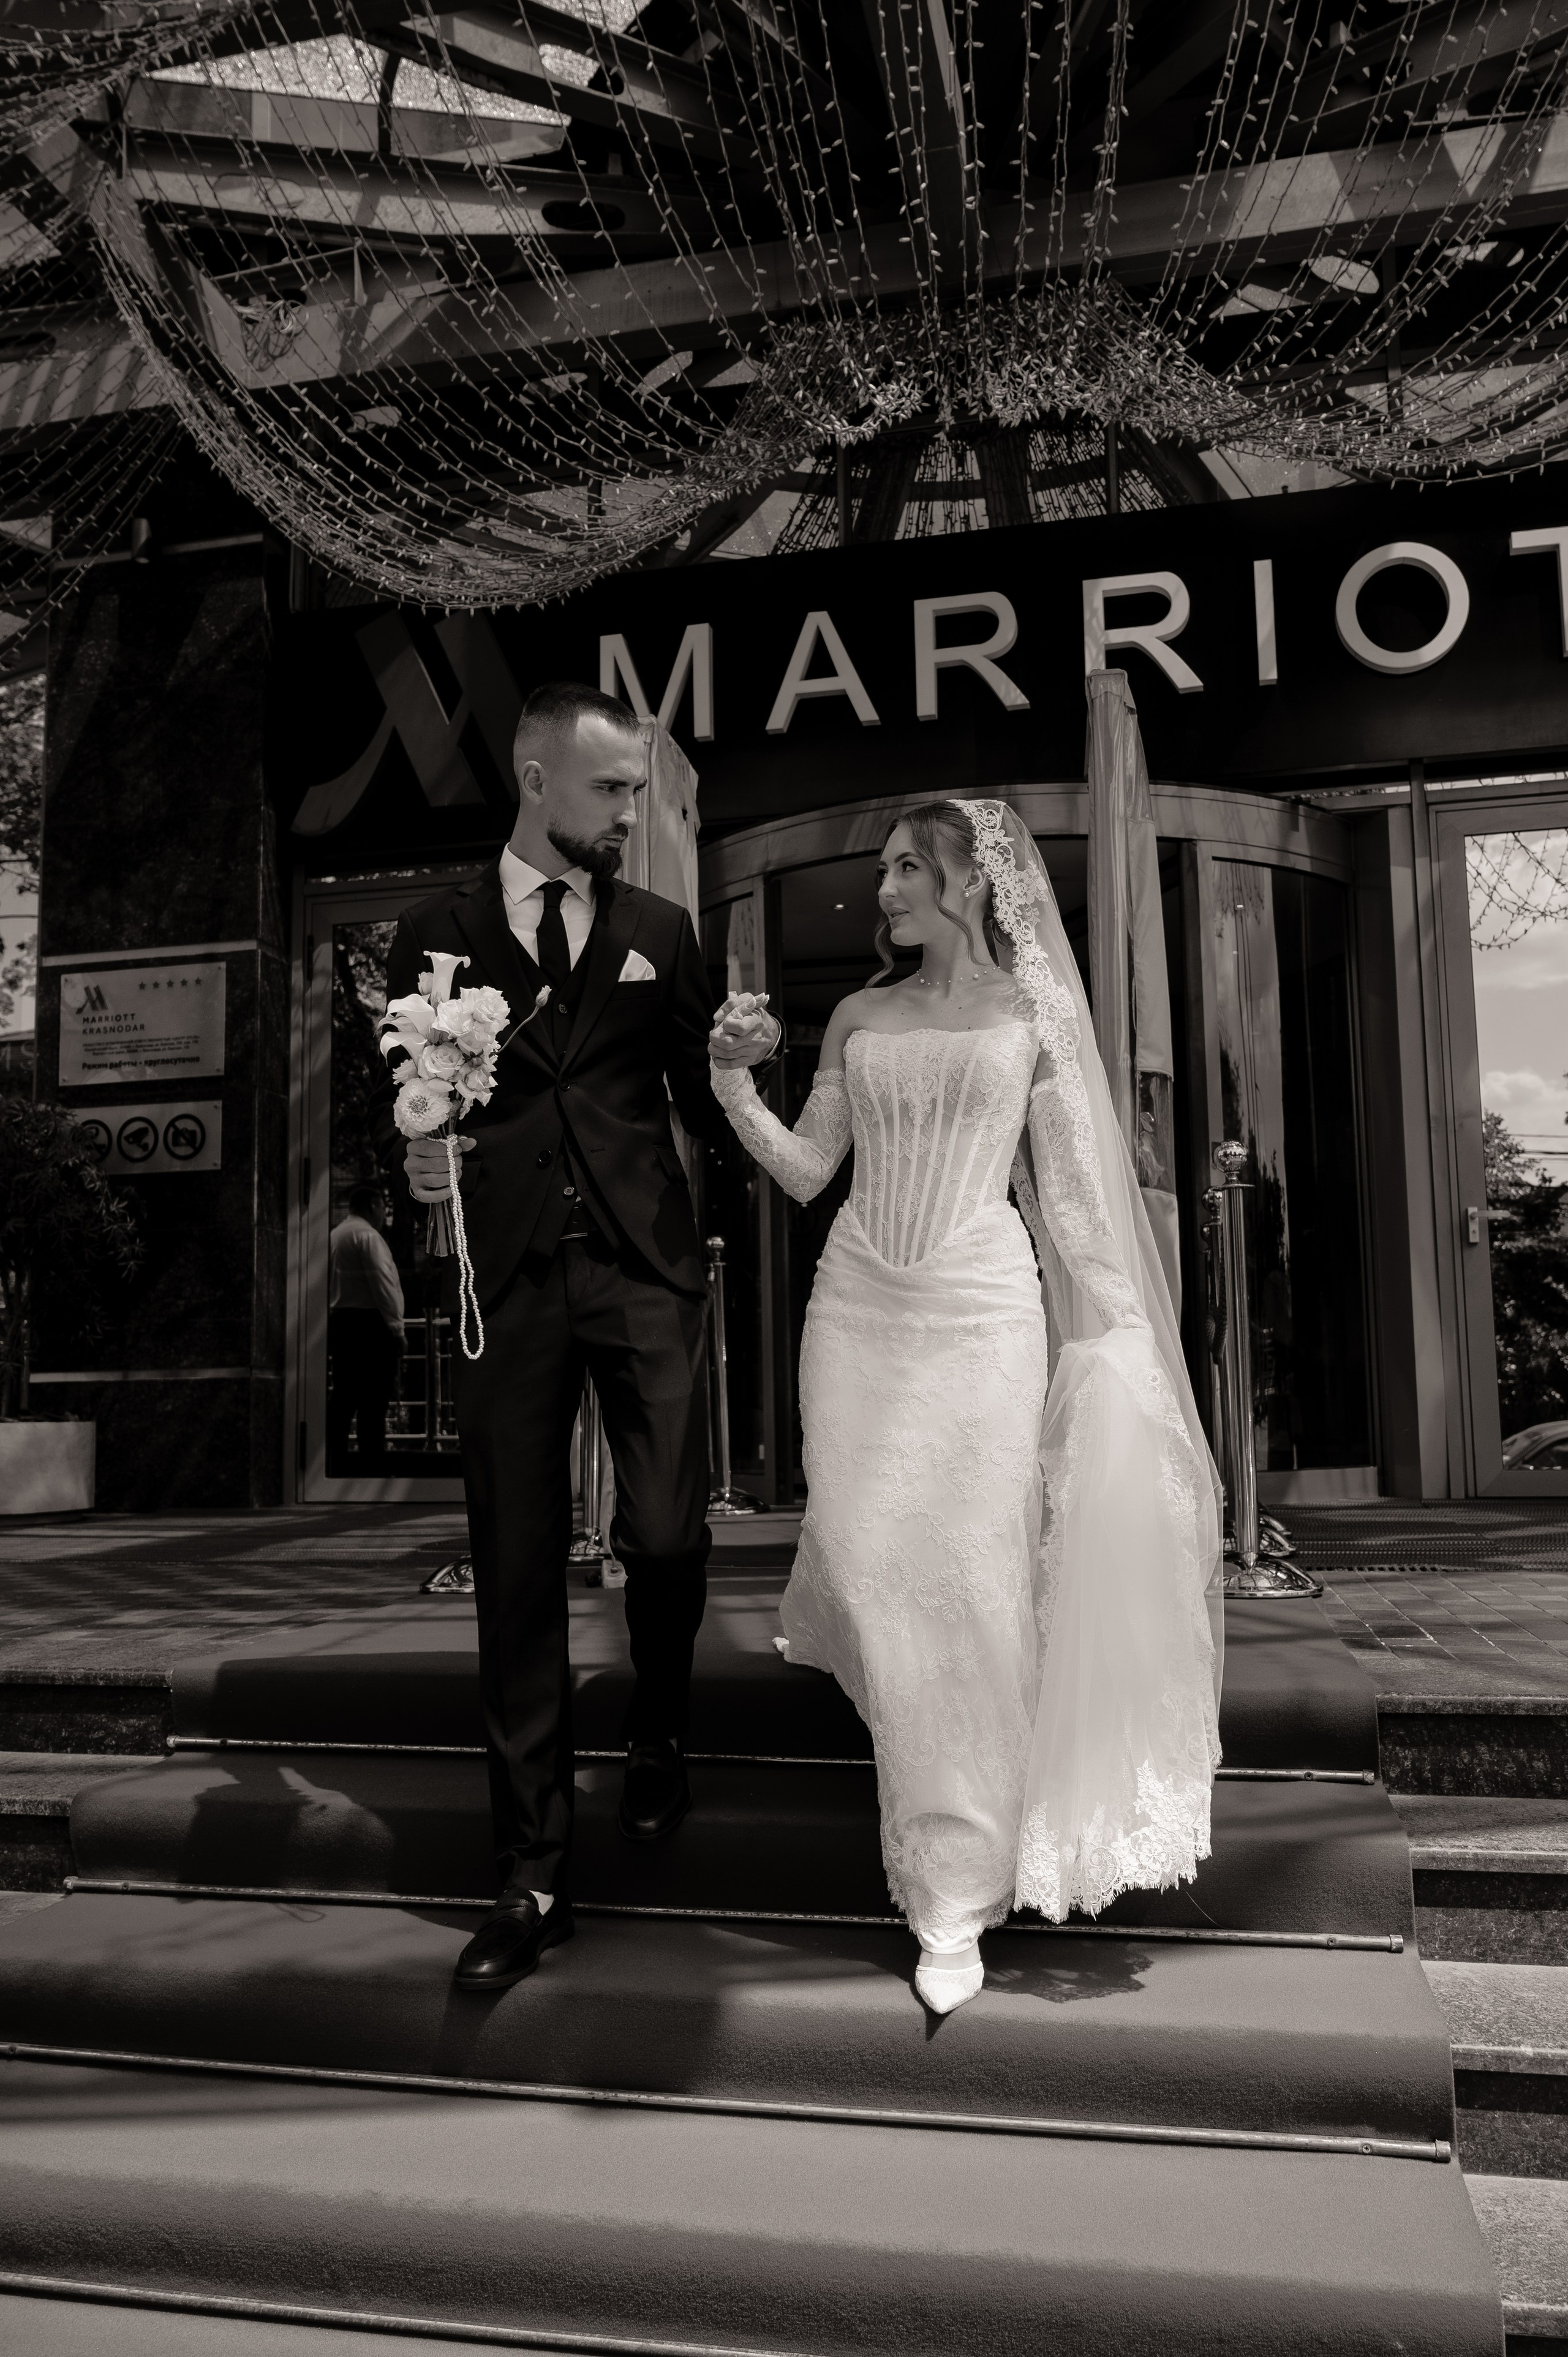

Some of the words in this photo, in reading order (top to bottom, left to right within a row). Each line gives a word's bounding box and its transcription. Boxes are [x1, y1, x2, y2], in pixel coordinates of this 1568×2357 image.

[83, 1013, 136, 1024] MARRIOTT
[82, 1024, 145, 1035] KRASNODAR
[109, 1060, 137, 1069] работы
[144, 1057, 200, 1068] круглосуточно
